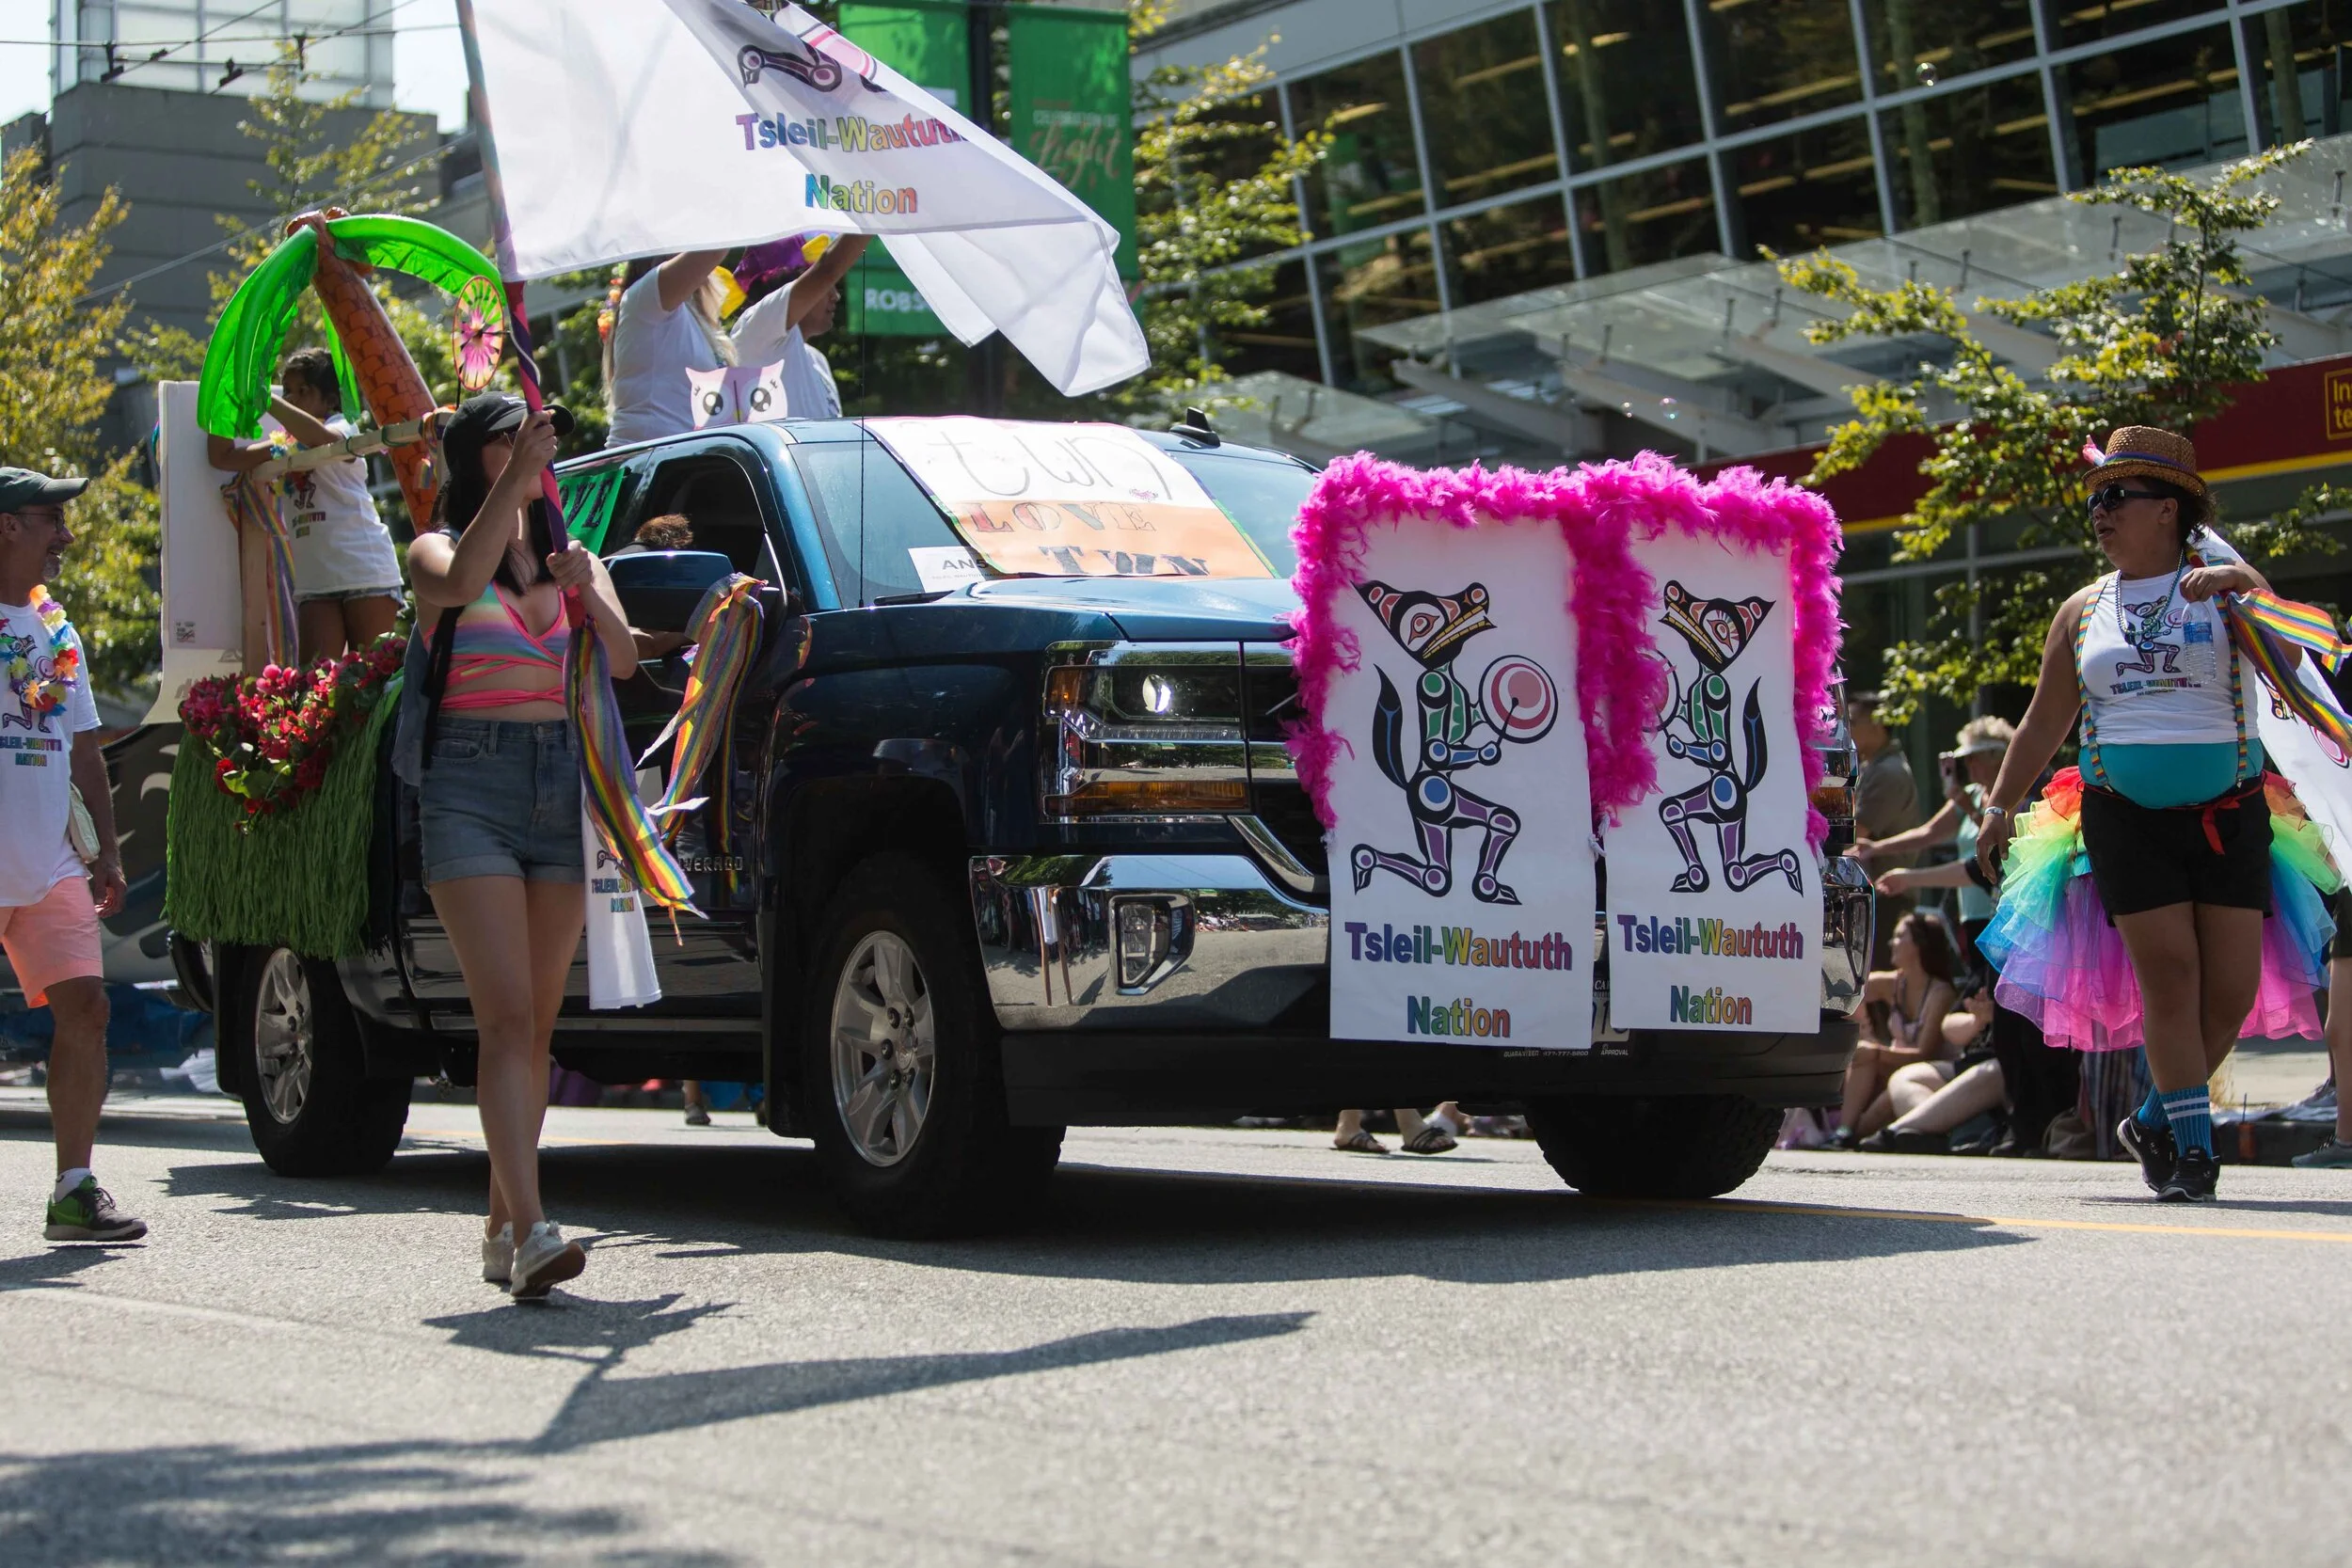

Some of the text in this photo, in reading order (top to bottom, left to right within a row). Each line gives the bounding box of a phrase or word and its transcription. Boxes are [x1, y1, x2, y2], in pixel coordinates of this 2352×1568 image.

[804, 173, 918, 214] Nation
[865, 288, 931, 313] ROBS
[2333, 377, 2352, 403] In
[2334, 405, 2352, 429] te
[559, 478, 613, 529] OVE
[963, 500, 1158, 533] LOVE
[1038, 546, 1211, 576] TWN
[679, 856, 743, 872] LVERADO
[1344, 922, 1572, 971] Tsleil-Waututh
[1617, 914, 1804, 959] Tsleil-Waututh
[1594, 980, 1610, 990] CA
[1407, 995, 1511, 1037] Nation
[1670, 985, 1752, 1025] Nation
